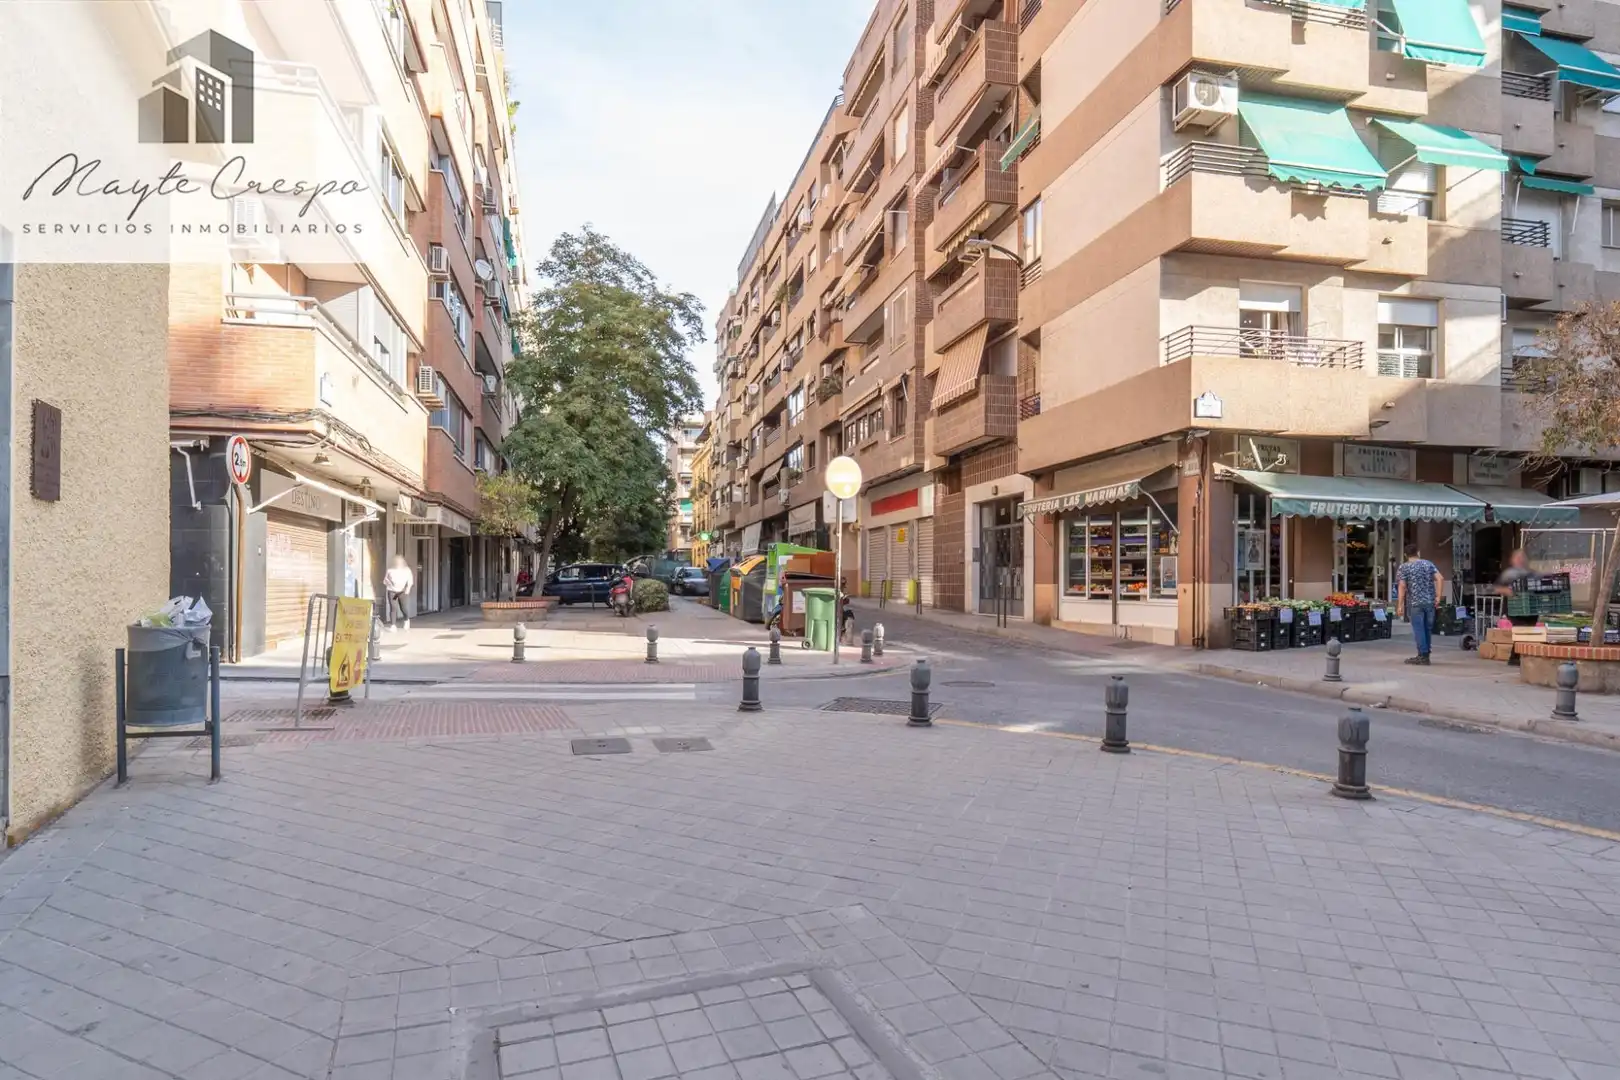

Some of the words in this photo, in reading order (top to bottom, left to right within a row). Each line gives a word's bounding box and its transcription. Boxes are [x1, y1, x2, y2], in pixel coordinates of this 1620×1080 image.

[291, 488, 320, 510] DESTINO
[1063, 494, 1081, 507] LAS
[1085, 484, 1131, 504] MARINAS
[1309, 501, 1371, 516] FRUTERIA
[1378, 504, 1401, 516] LAS
[1409, 505, 1459, 517] MARINAS
